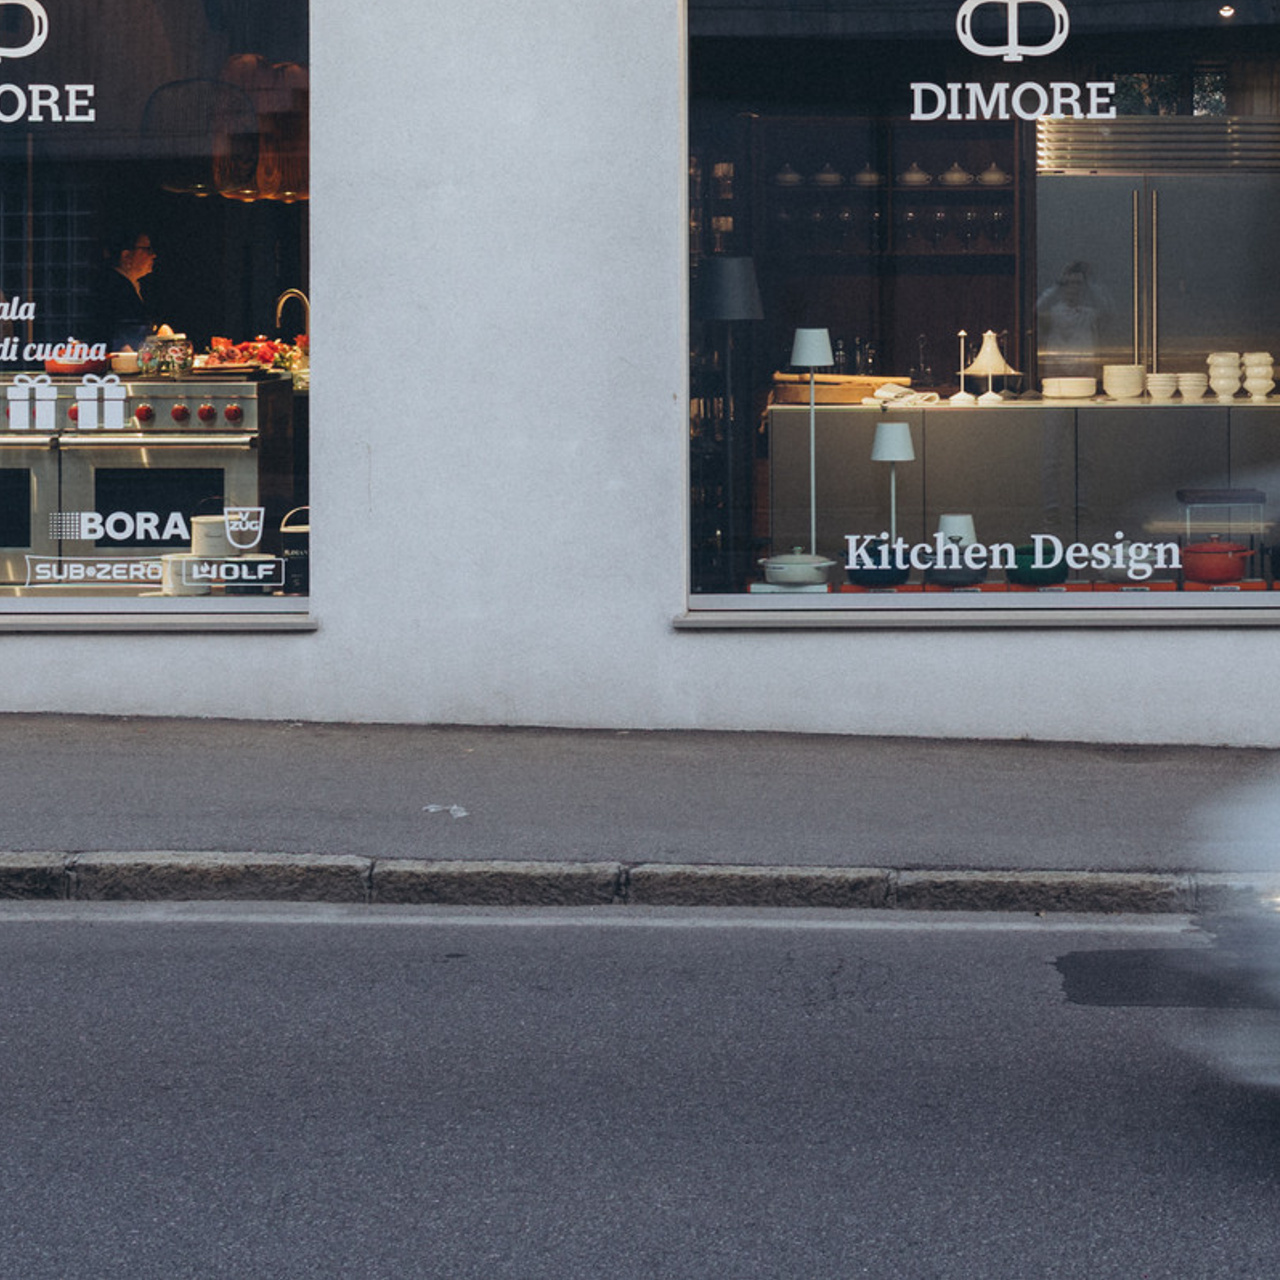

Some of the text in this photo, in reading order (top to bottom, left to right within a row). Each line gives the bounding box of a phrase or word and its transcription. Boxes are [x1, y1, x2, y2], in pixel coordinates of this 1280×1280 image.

[909, 81, 1117, 121] DIMORE
[22, 336, 107, 361] cucina
[80, 511, 191, 540] BORA
[844, 530, 1182, 580] Kitchen Design
[192, 560, 277, 580] WOLF
